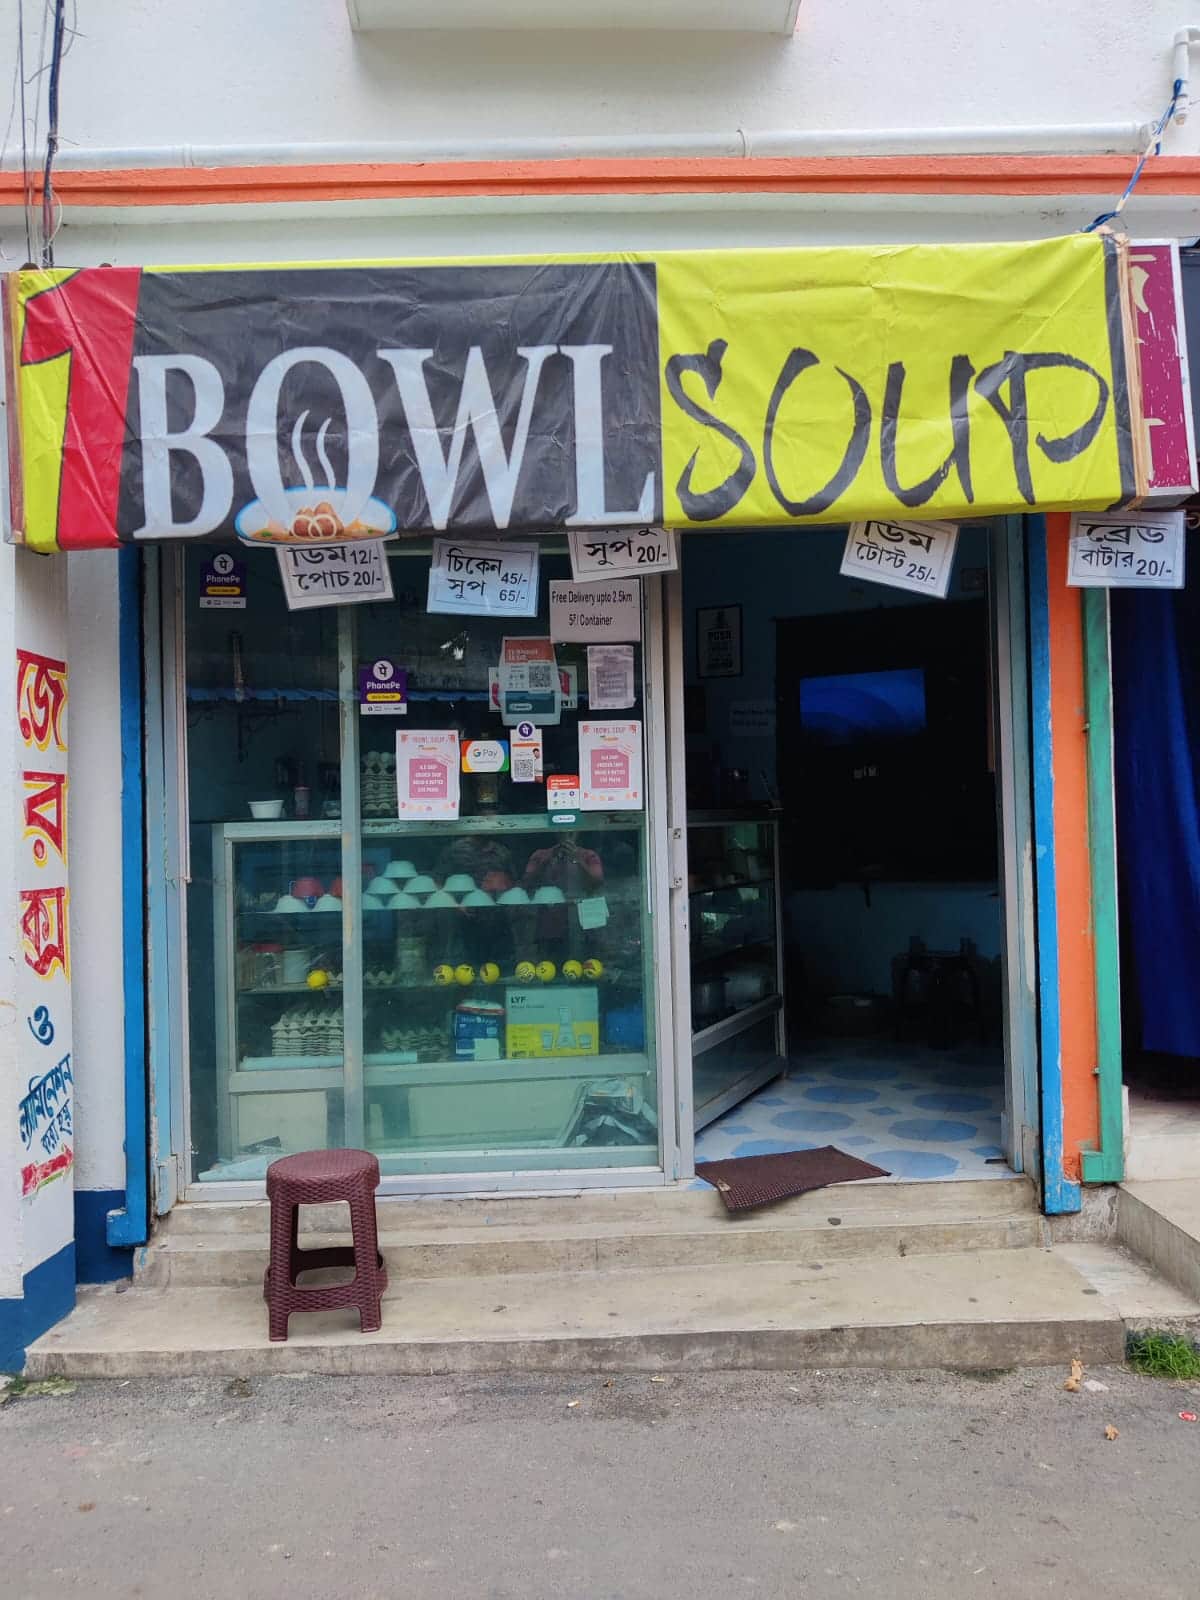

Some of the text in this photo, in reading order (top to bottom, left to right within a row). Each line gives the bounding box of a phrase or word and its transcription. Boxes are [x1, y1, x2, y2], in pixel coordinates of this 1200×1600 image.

[132, 344, 657, 540] BOWL
[665, 338, 1111, 522] SOUP
[350, 550, 379, 565] 12/-
[637, 544, 667, 563] 20/-
[1079, 544, 1172, 576] বাটার 20/-
[446, 547, 502, 576] চিকেন
[353, 571, 382, 586] 20/-
[501, 571, 527, 585] 45/-
[906, 563, 936, 582] 25/-
[499, 589, 526, 602] 65/-
[552, 590, 567, 603] Free
[568, 590, 595, 606] Delivery
[580, 613, 613, 626] Container
[366, 681, 401, 690] PhonePe
[482, 748, 498, 760] Pay
